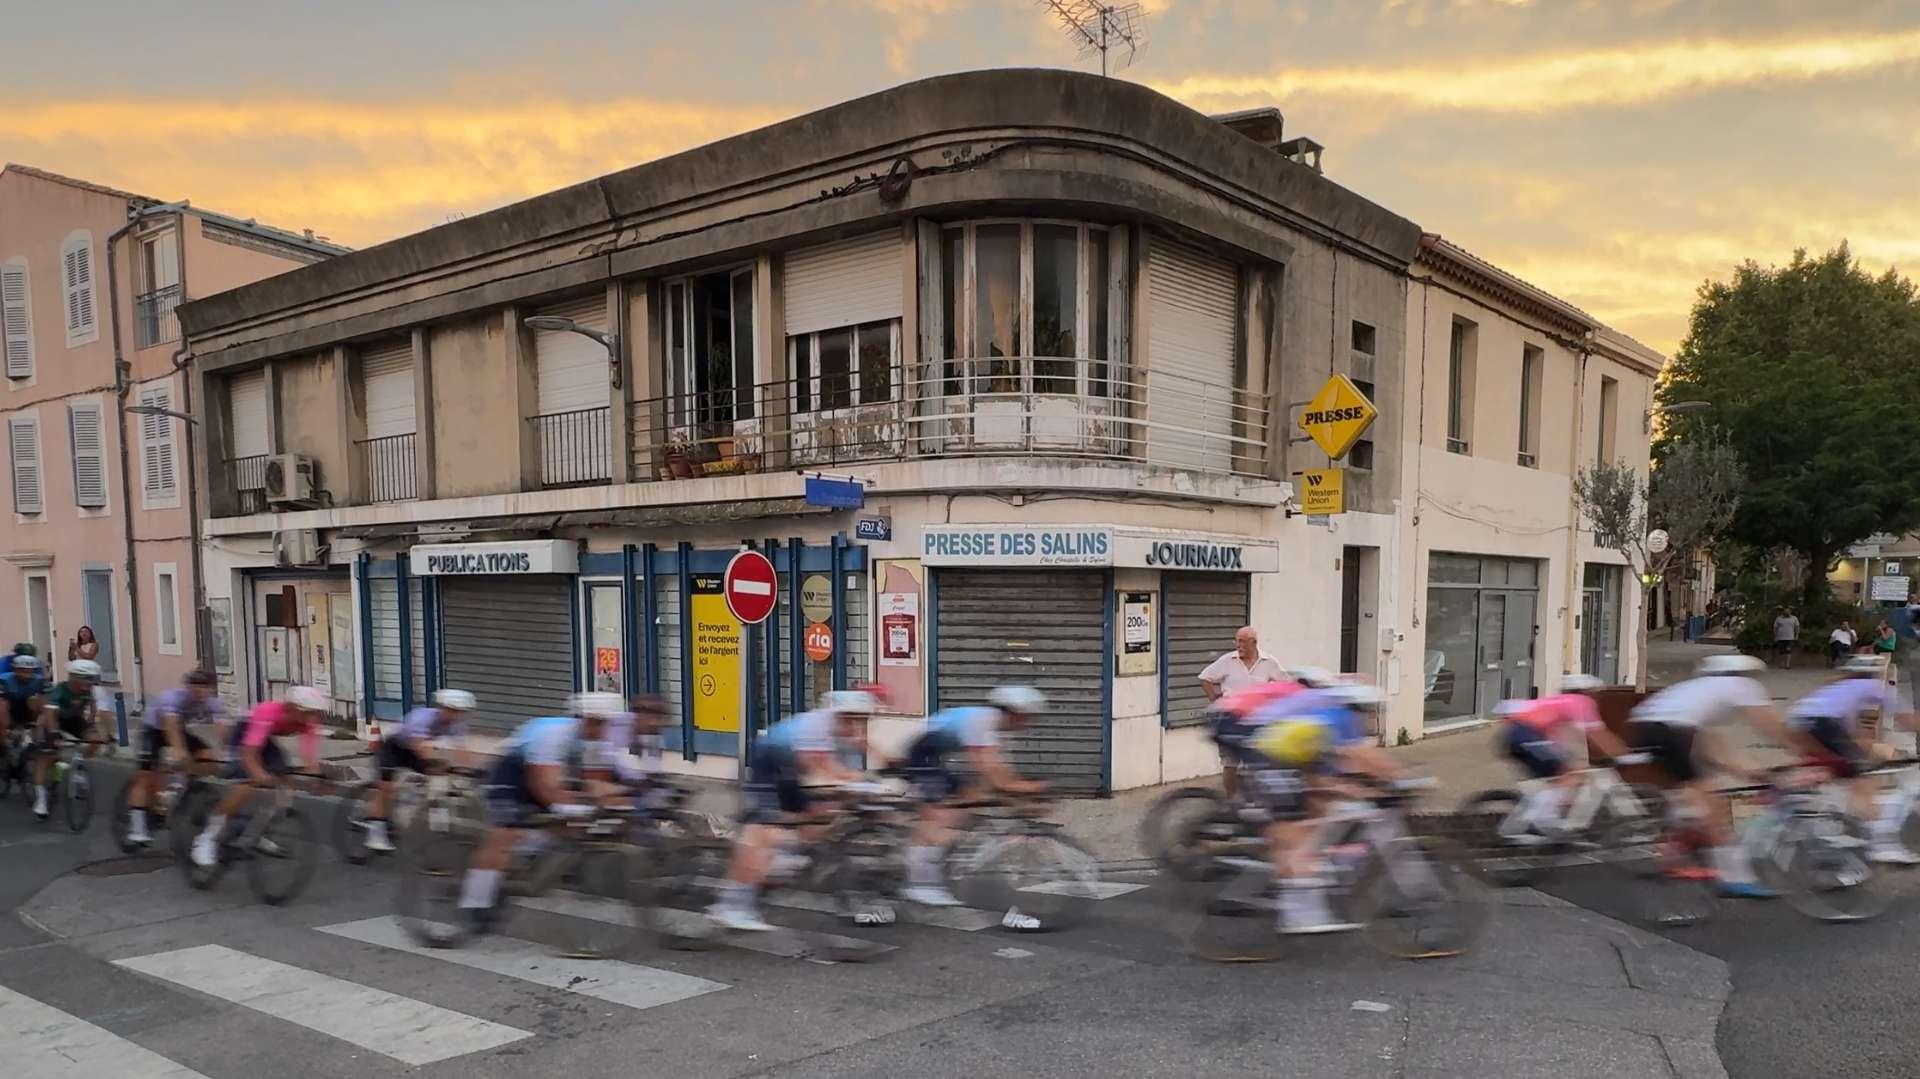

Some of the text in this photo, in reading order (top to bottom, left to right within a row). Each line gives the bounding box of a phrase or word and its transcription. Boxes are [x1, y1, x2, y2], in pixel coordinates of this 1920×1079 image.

[1305, 406, 1364, 425] PRESSE
[1307, 489, 1339, 497] Western
[1307, 497, 1330, 505] Union
[861, 521, 875, 532] FDJ
[924, 532, 1107, 555] PRESSE DES SALINS
[1146, 542, 1242, 568] JOURNAUX
[428, 552, 530, 572] PUBLICATIONS
[698, 623, 730, 633] Envoyez
[699, 635, 739, 643] et recevez
[808, 627, 831, 649] ria
[699, 646, 709, 655] de
